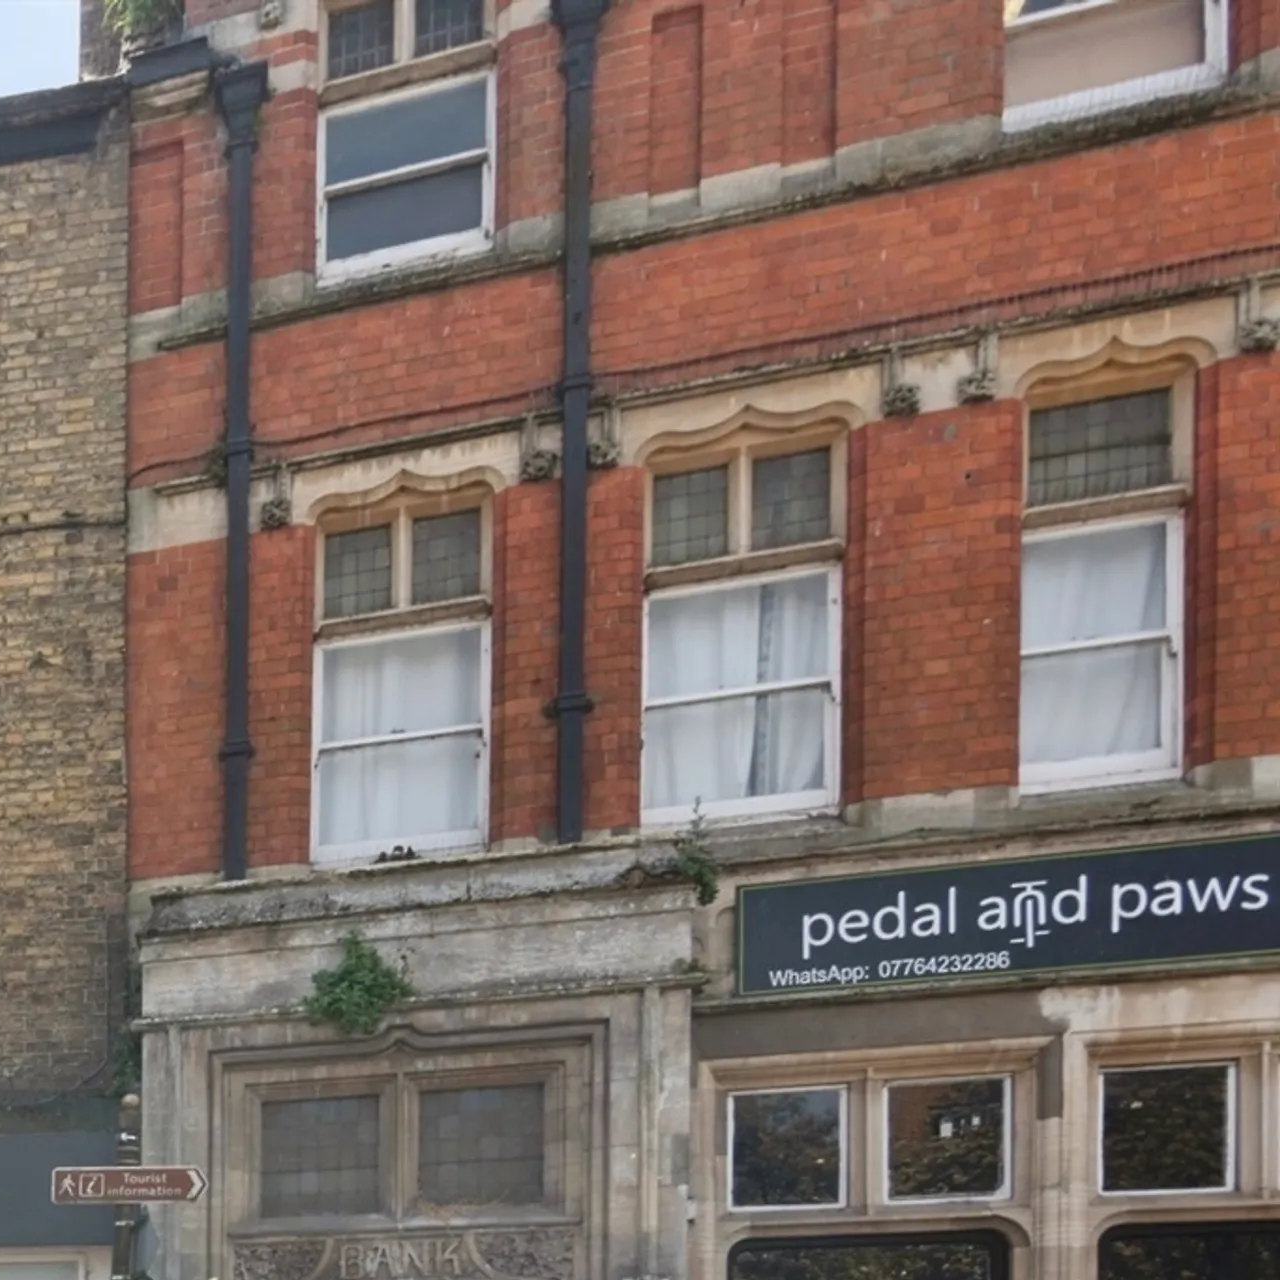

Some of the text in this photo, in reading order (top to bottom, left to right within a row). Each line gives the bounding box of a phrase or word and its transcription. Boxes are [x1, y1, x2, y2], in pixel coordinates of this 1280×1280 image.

[802, 873, 1270, 961] pedal and paws
[769, 950, 1011, 988] WhatsApp: 07764232286
[107, 1186, 182, 1197] information
[122, 1173, 168, 1185] Tourist
[339, 1241, 461, 1280] BANK
